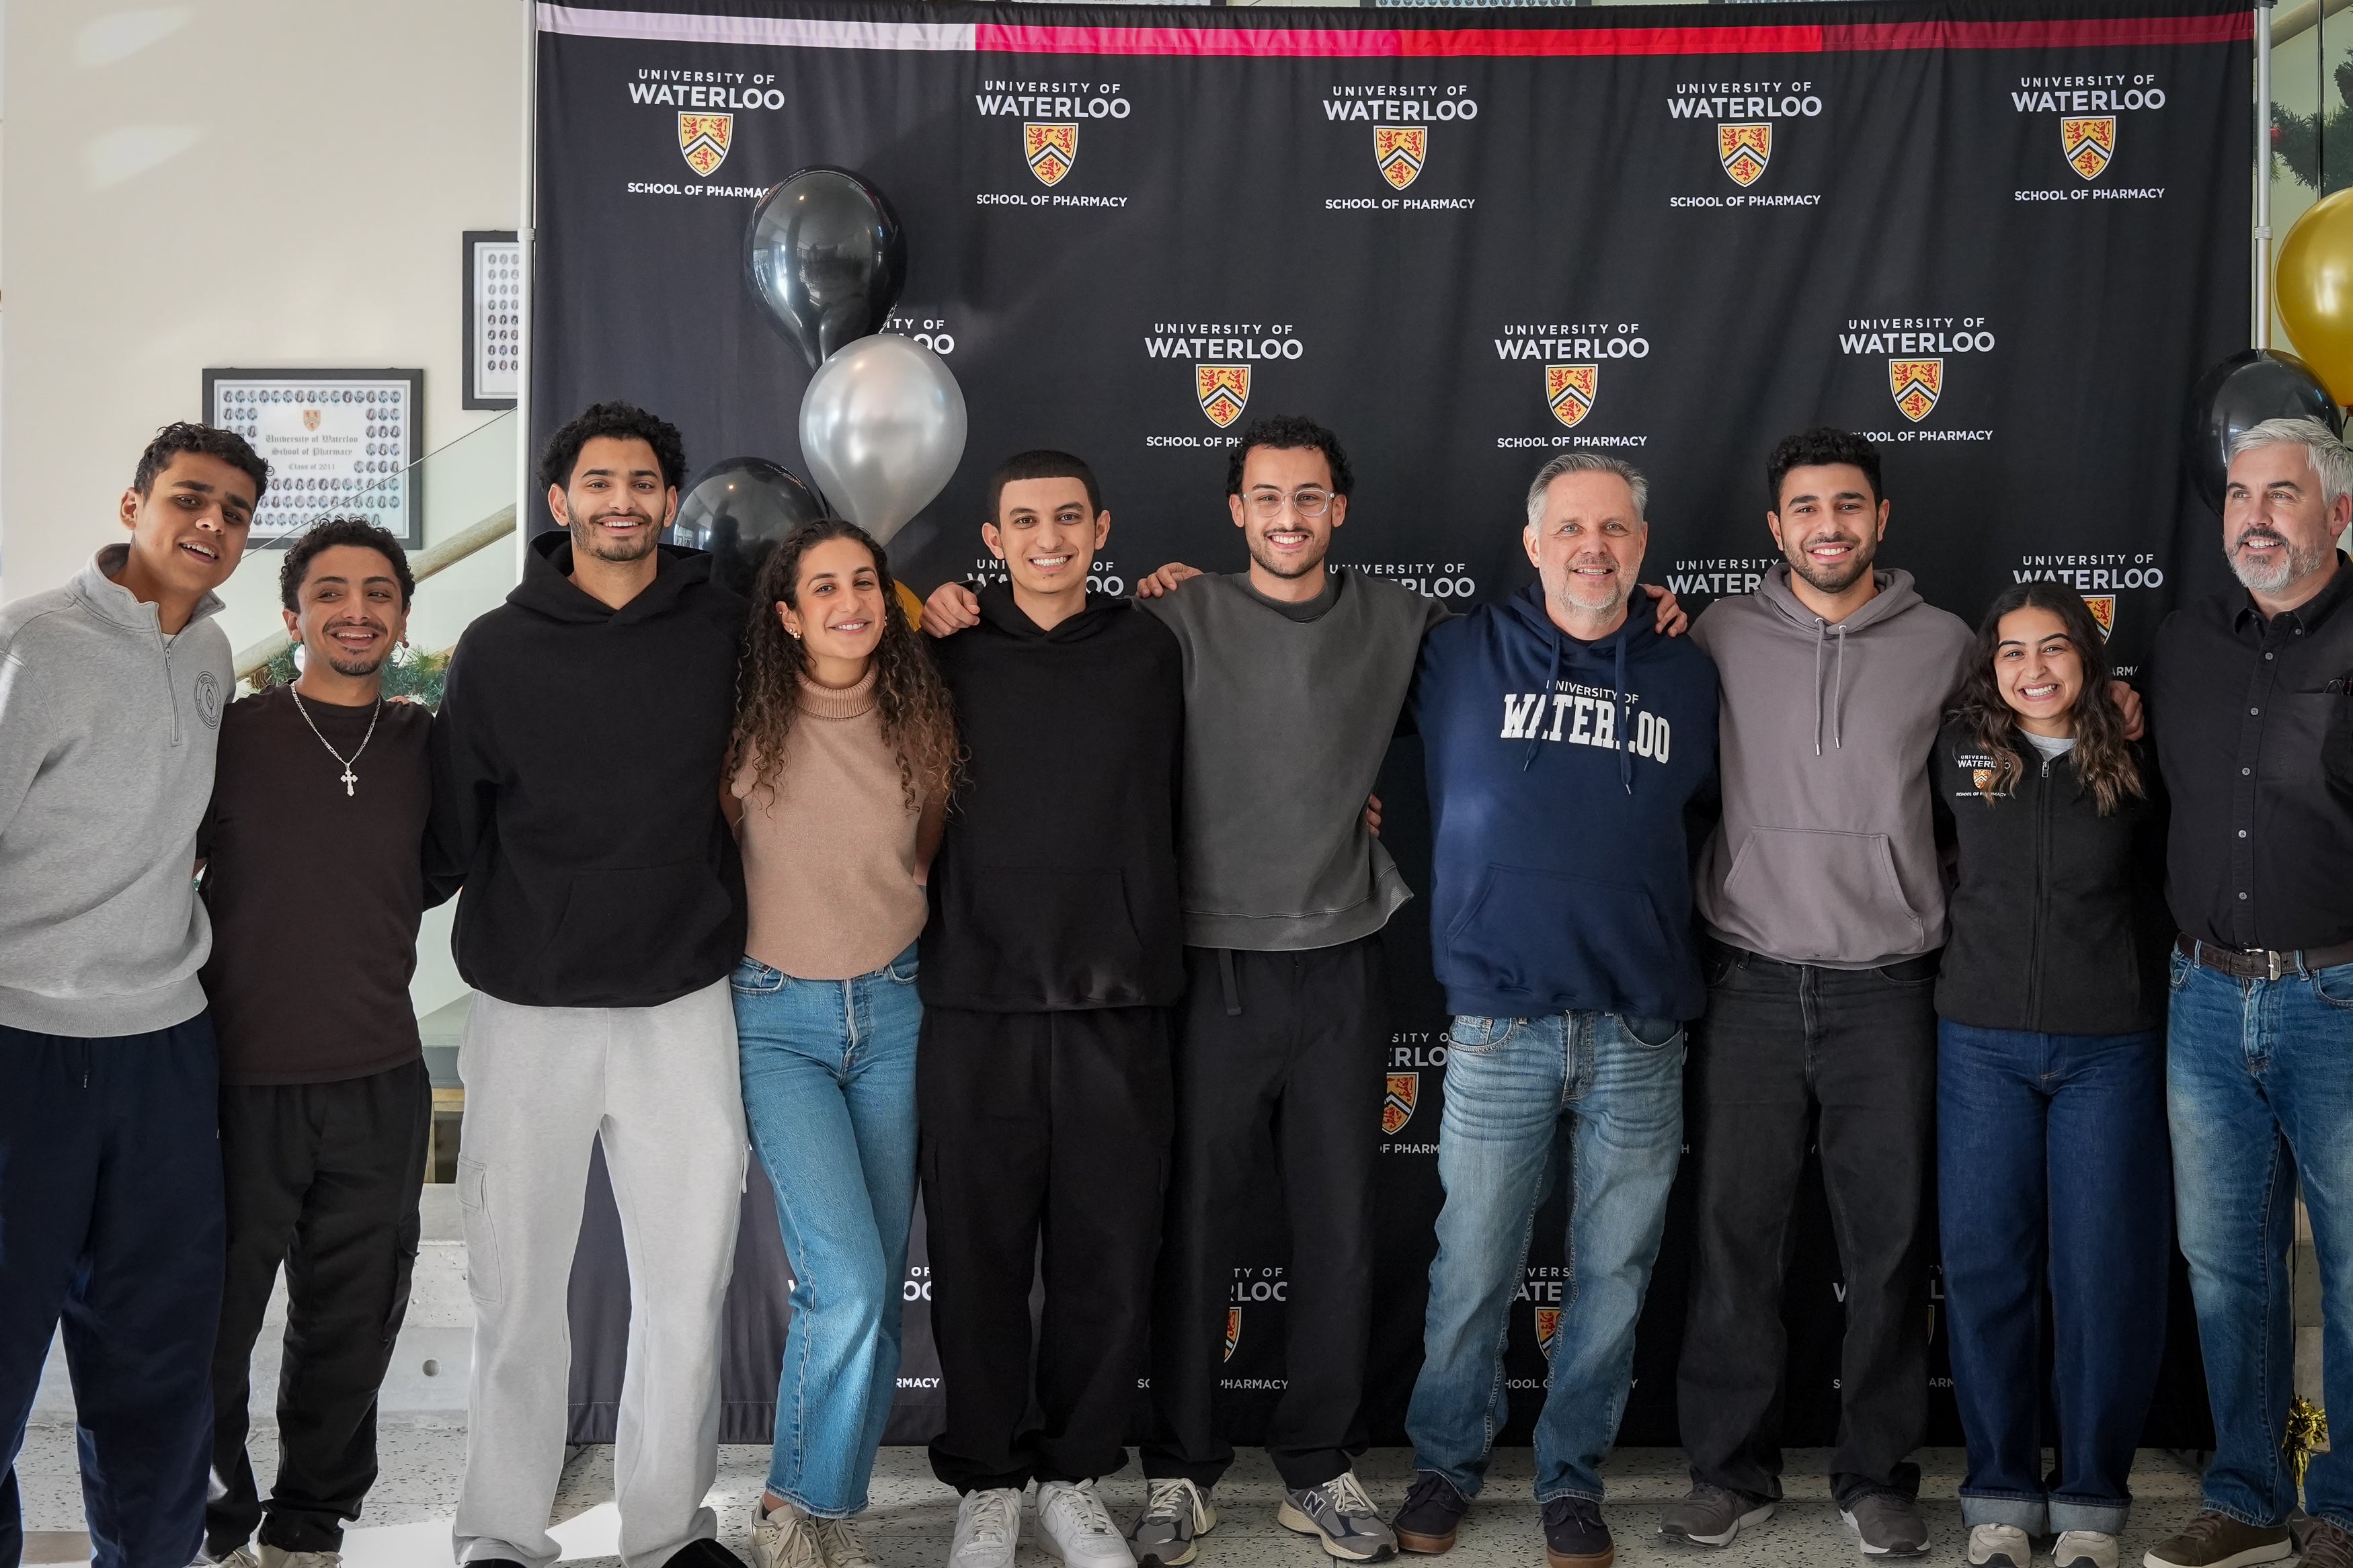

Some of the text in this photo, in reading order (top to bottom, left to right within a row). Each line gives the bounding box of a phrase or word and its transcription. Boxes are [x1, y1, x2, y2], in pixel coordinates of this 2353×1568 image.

[639, 69, 775, 85] UNIVERSITY OF
[2021, 74, 2155, 87] UNIVERSITY OF
[985, 80, 1121, 94] UNIVERSITY OF
[1332, 85, 1468, 97] UNIVERSITY OF
[1677, 81, 1812, 94] UNIVERSITY OF
[628, 83, 785, 110] WATERLOO
[2011, 88, 2165, 112] WATERLOO
[975, 95, 1131, 119] WATERLOO
[1322, 99, 1478, 121] WATERLOO
[1667, 95, 1823, 119] WATERLOO
[627, 182, 769, 198] SCHOOL OF PHARMA
[2014, 188, 2165, 201] SCHOOL OF PHARMACY
[976, 194, 1128, 207] SCHOOL OF PHARMACY
[1325, 198, 1476, 210] SCHOOL OF PHARMACY
[1670, 194, 1821, 207] SCHOOL OF PHARMACY
[923, 319, 945, 330] OF
[1154, 323, 1293, 335] UNIVERSITY OF
[1505, 323, 1639, 335] UNIVERSITY OF
[1848, 317, 1985, 330] UNIVERSITY OF
[1144, 337, 1304, 360] WATERLOO
[1494, 337, 1650, 360] WATERLOO
[1839, 331, 1995, 354] WATERLOO
[266, 435, 309, 443] University
[322, 435, 358, 443] Waterloo
[1146, 436, 1201, 447] SCHOOL
[1203, 437, 1222, 447] OF
[1497, 436, 1648, 448] SCHOOL OF PHARMACY
[1850, 430, 1993, 442] OOL OF PHARMACY
[313, 448, 353, 456] Pharmacy
[311, 462, 317, 470] of
[1676, 559, 1780, 571] UNIVERSITY
[2022, 554, 2154, 566] UNIVERSITY OF
[1092, 561, 1114, 572] OF
[1329, 563, 1466, 574] UVERSITY OF
[1666, 573, 1768, 595] WATER
[2012, 568, 2163, 590] WATERLOO
[1389, 577, 1476, 598] RLOO
[1624, 693, 1639, 704] OF
[1958, 759, 2011, 770] WATERLO
[1394, 1144, 1440, 1154] PHARM
[911, 1266, 930, 1277] OF
[1262, 1268, 1283, 1277] OF
[896, 1378, 940, 1389] RMACY
[1505, 1378, 1540, 1389] HOOL
